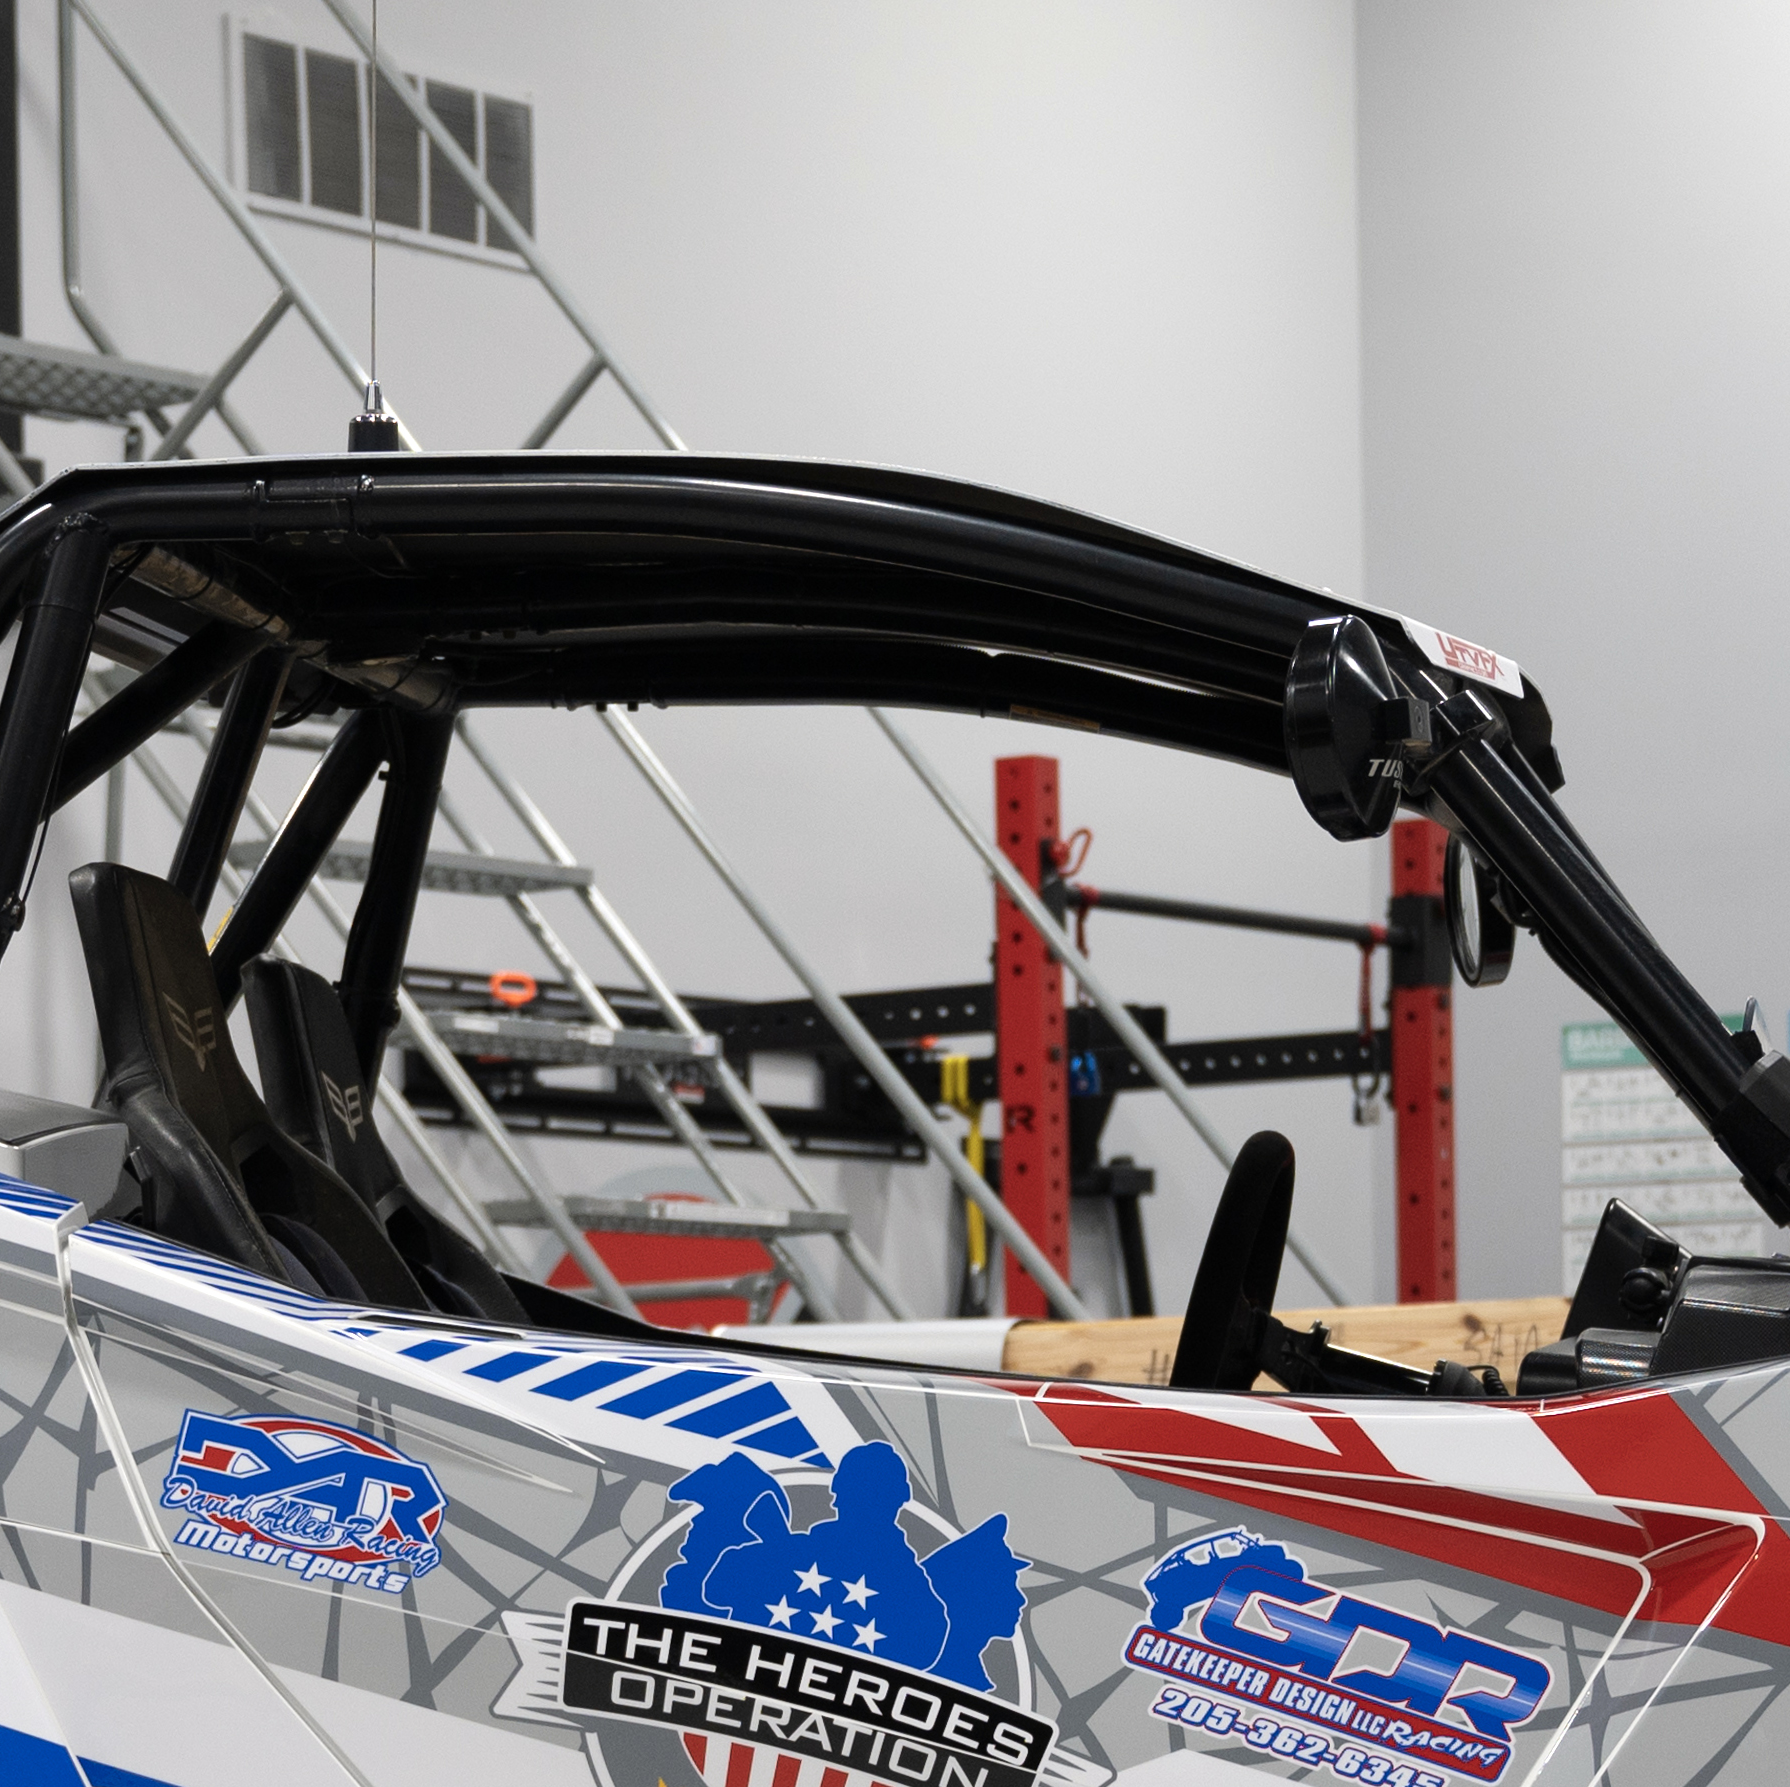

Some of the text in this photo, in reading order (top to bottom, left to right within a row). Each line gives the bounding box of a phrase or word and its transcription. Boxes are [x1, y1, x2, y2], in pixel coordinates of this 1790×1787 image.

[1368, 758, 1404, 778] TUS
[174, 1519, 412, 1594] Motorsports
[339, 1515, 441, 1577] Racing
[583, 1617, 1035, 1765] THE HEROES
[1133, 1632, 1505, 1769] GATEKEEPER DESIGN LLC RACING
